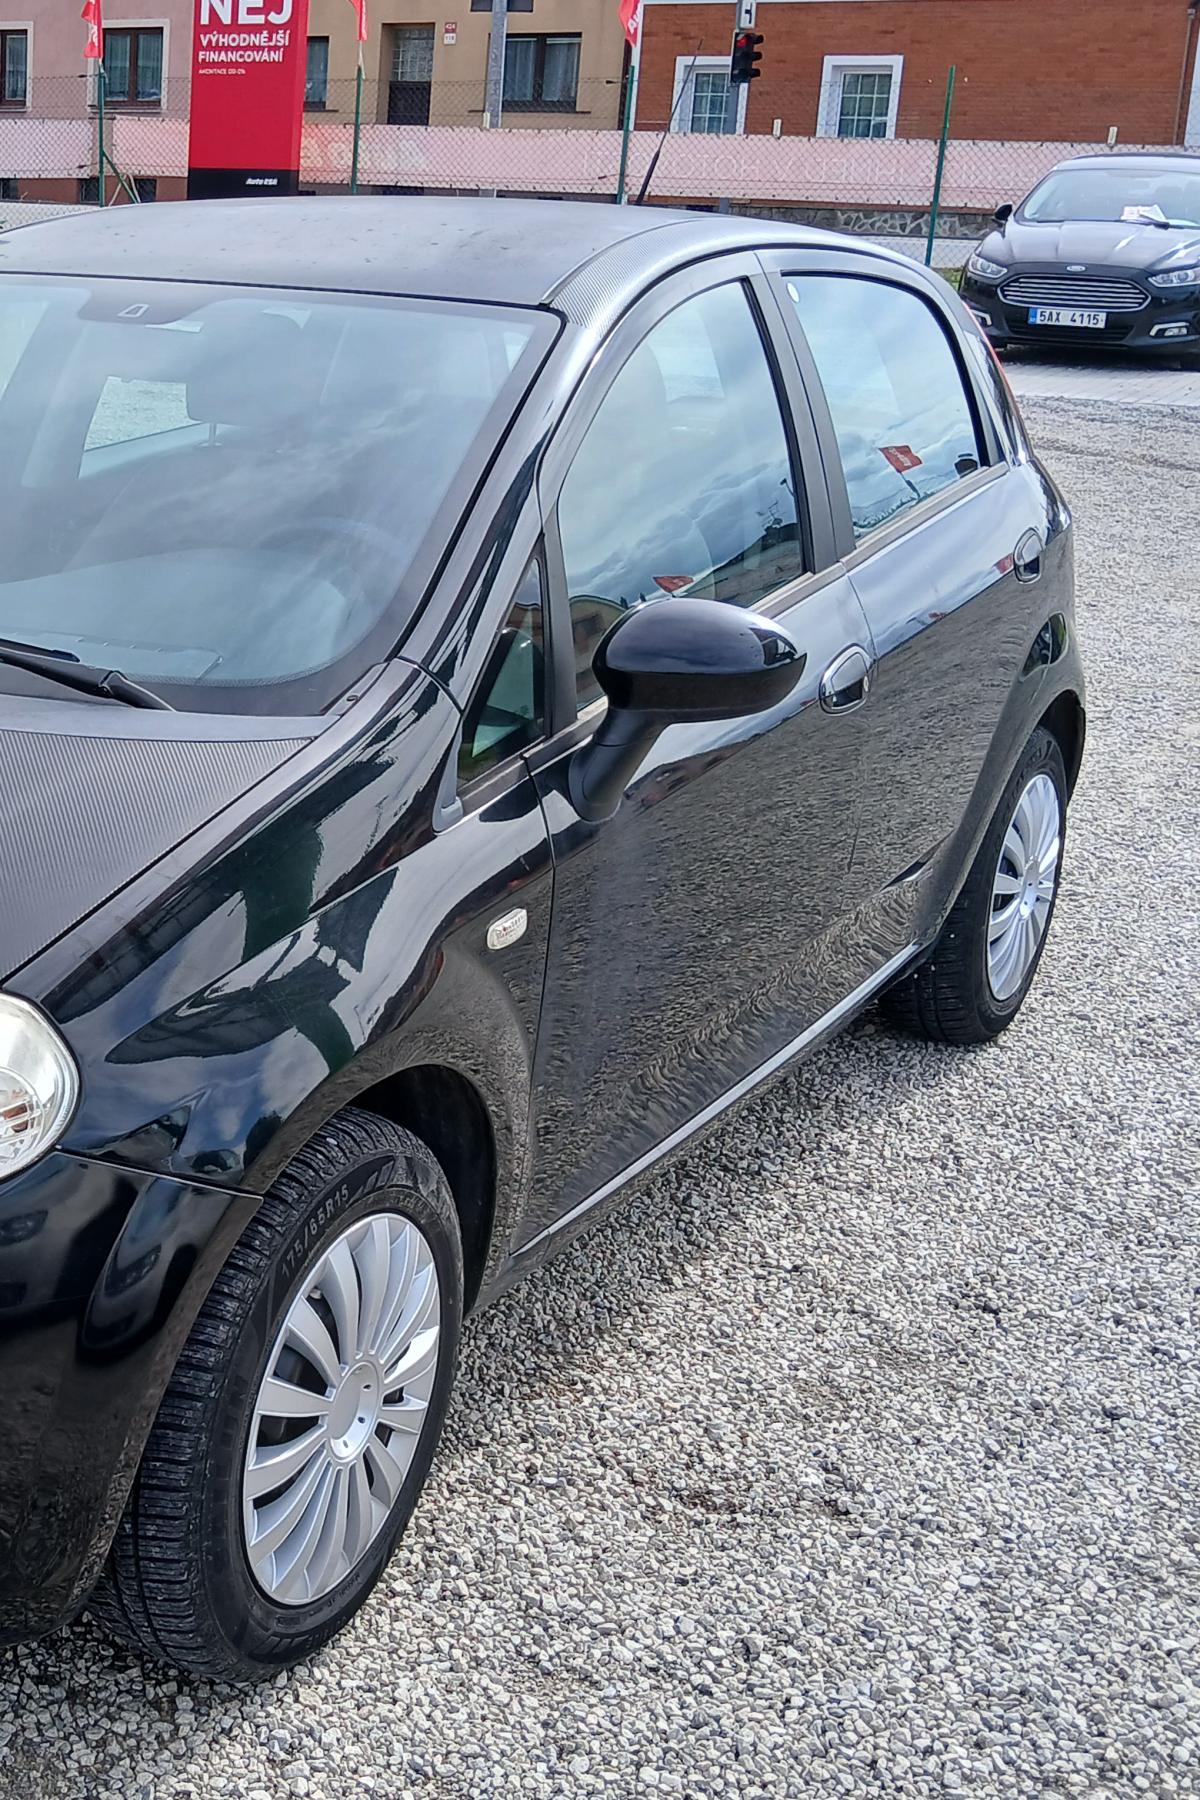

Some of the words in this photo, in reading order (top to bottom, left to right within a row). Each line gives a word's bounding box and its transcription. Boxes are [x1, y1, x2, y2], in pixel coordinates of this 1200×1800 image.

[200, 0, 293, 25] NEJ
[200, 29, 291, 48] VÝHODNĚJŠÍ
[198, 47, 284, 64] FINANCOVÁNÍ
[1039, 310, 1061, 323] 5AX
[1070, 312, 1100, 326] 4115
[282, 1183, 349, 1278] 175/65R15
